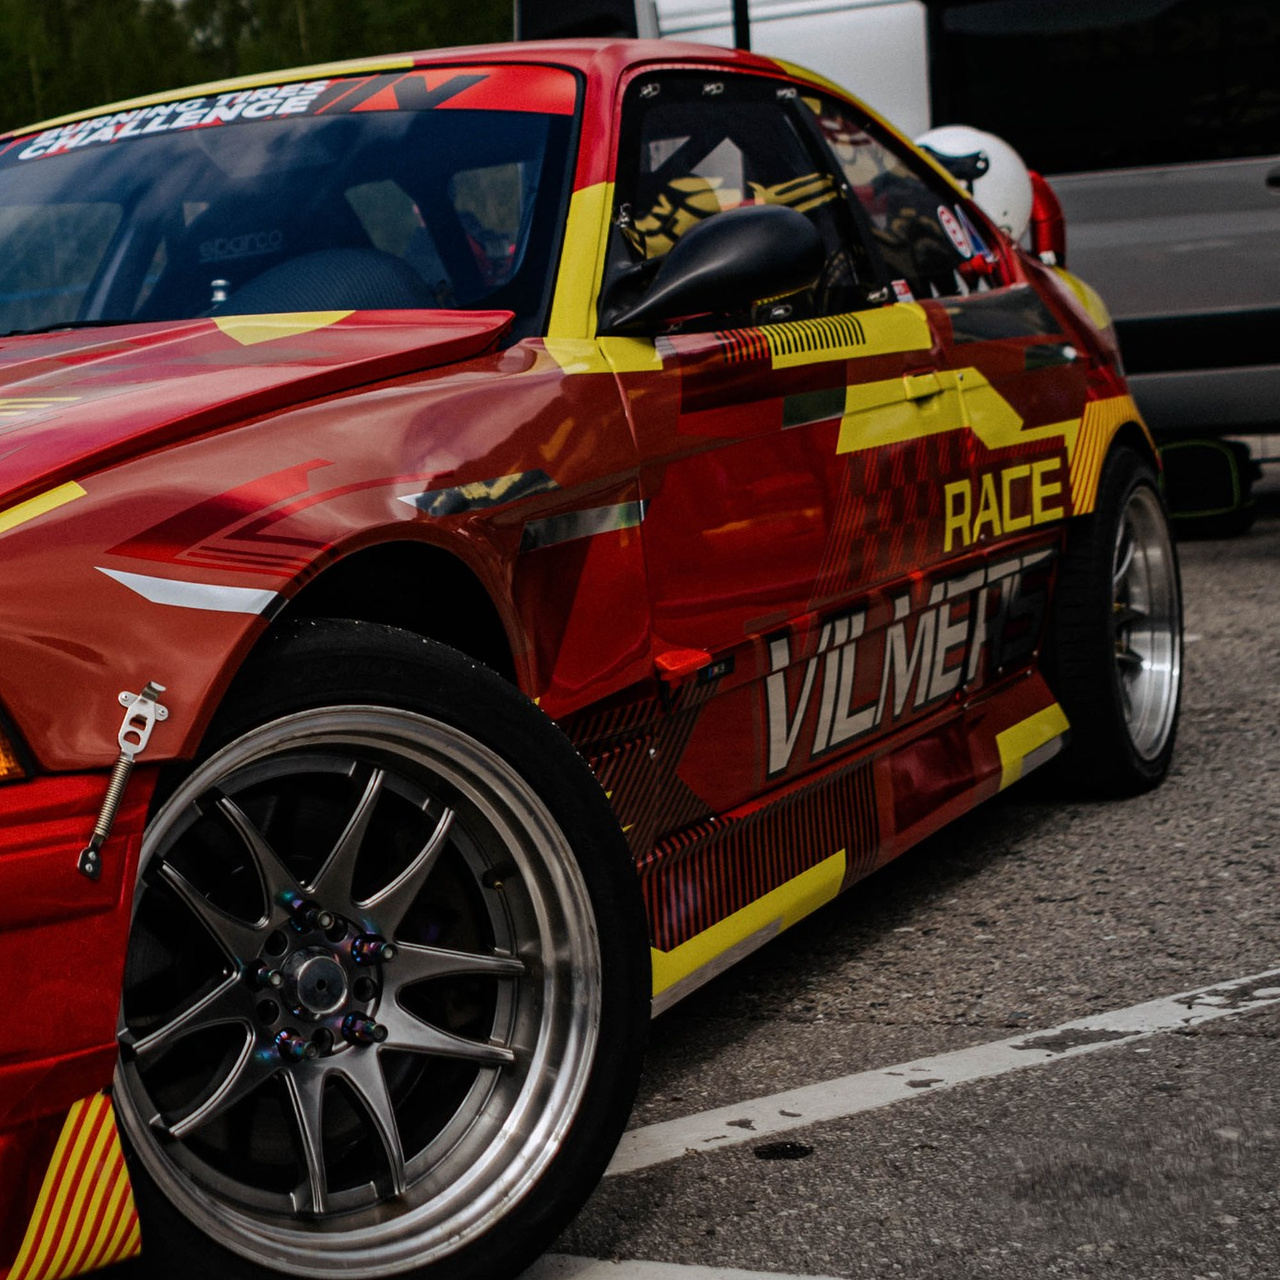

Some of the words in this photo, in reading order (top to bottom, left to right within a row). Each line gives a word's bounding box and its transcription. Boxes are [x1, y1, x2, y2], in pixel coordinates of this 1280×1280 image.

[17, 93, 319, 160] CHALLENGE
[32, 97, 207, 144] BURNING
[215, 80, 331, 107] TIRES
[198, 230, 283, 257] sparco
[944, 457, 1064, 553] RACE
